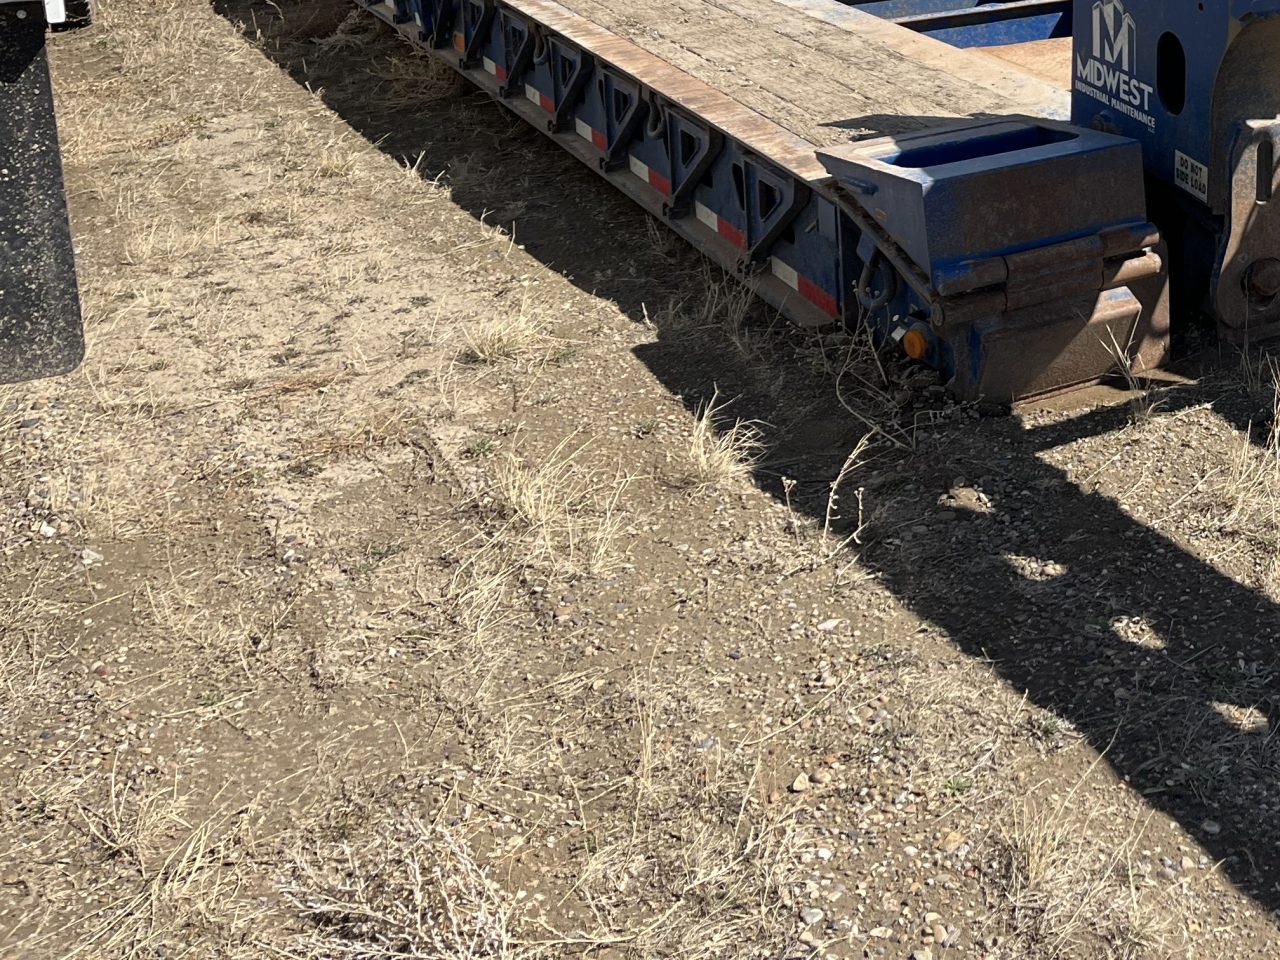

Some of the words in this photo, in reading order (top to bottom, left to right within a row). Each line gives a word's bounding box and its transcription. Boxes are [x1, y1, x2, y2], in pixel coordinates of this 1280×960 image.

[1076, 52, 1154, 111] MIDWEST
[1075, 79, 1110, 106] INDUSTRIAL
[1111, 97, 1156, 128] MAINTENANCE
[1180, 155, 1189, 170] DO
[1190, 161, 1202, 179] NOT
[1190, 176, 1207, 195] LOAD
